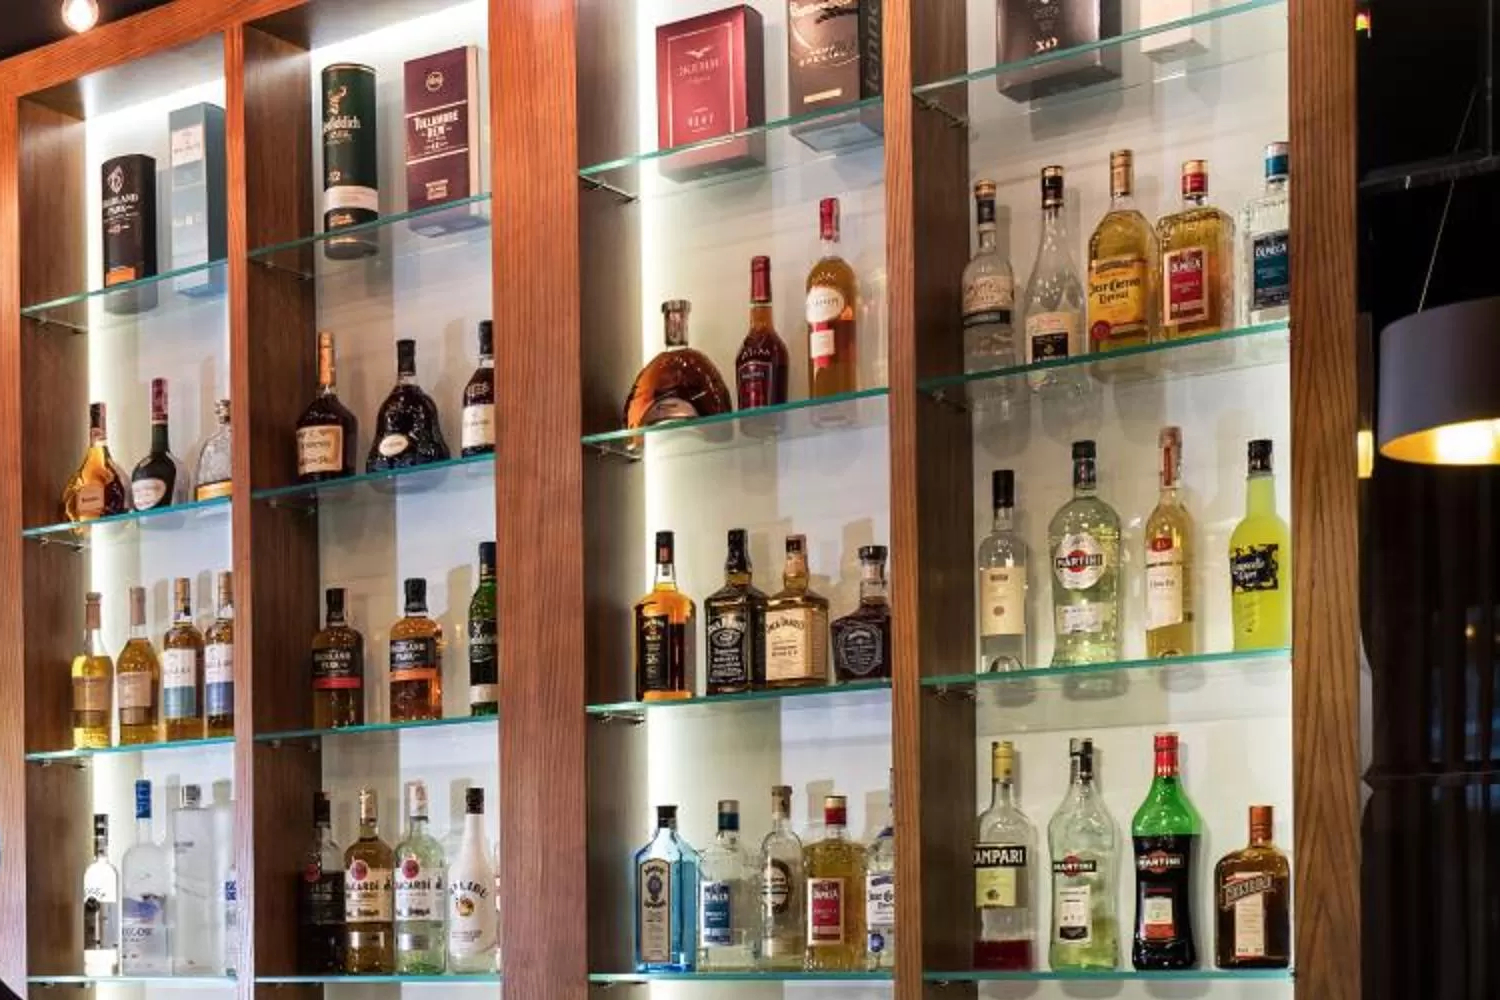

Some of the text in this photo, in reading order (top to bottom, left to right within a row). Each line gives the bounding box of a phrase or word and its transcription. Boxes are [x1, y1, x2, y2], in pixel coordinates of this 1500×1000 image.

[1056, 554, 1102, 569] MARTINI
[1053, 861, 1094, 872] MARTINI
[1138, 857, 1182, 868] MARTINI
